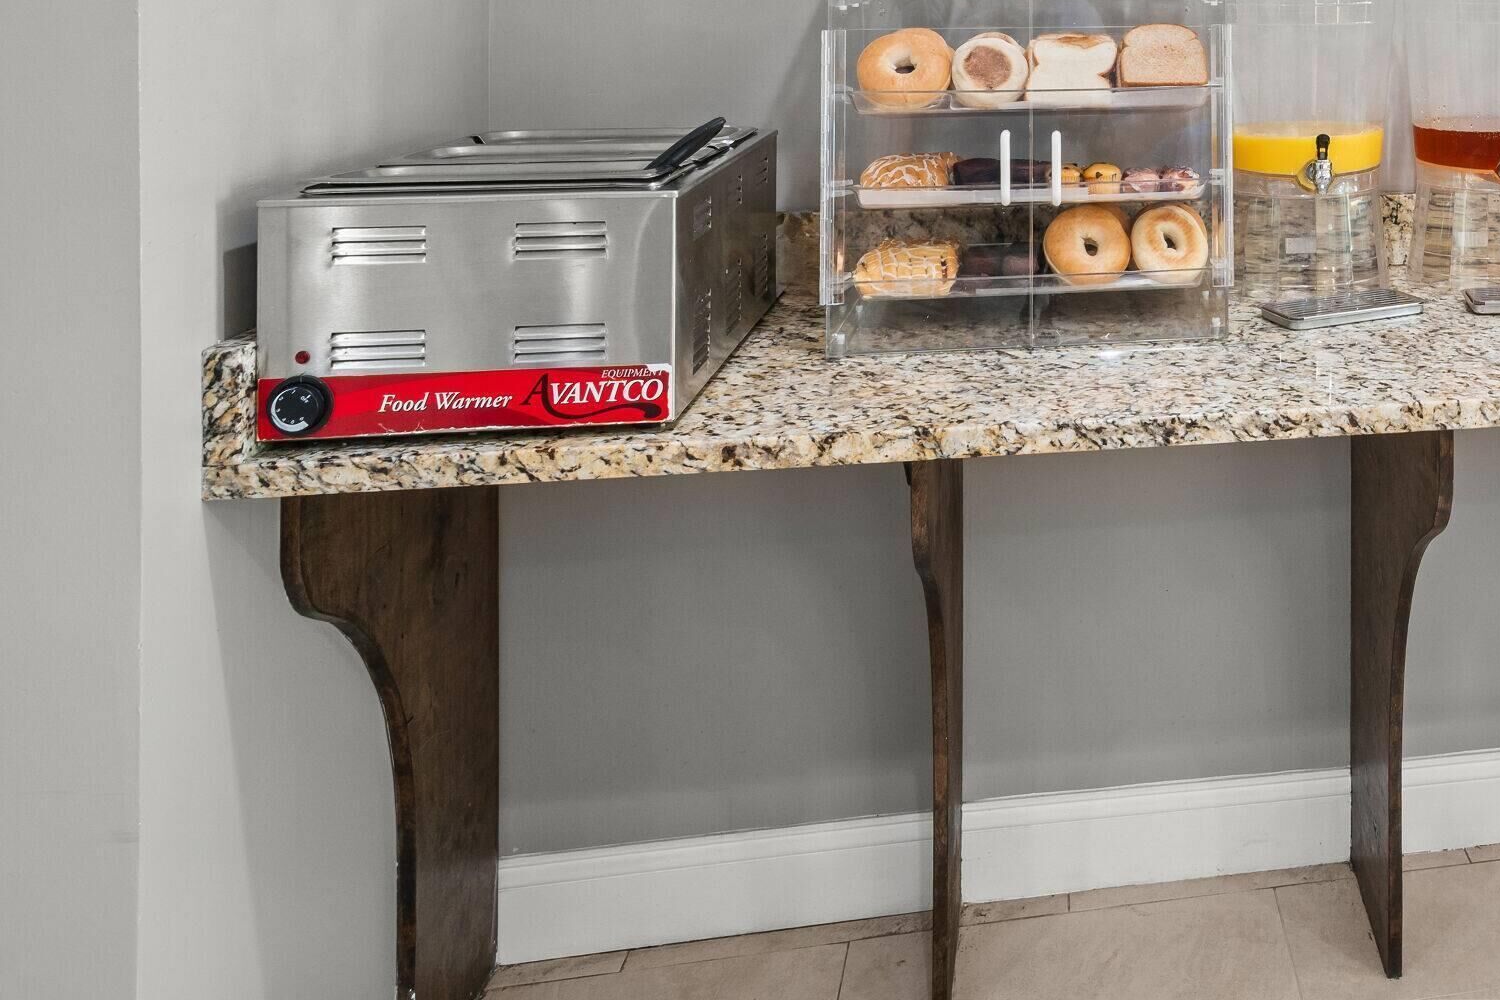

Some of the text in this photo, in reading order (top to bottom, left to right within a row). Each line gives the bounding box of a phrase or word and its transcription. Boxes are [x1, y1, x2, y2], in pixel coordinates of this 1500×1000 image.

[377, 391, 513, 413] Food Warmer
[520, 373, 664, 412] AVANTCO
